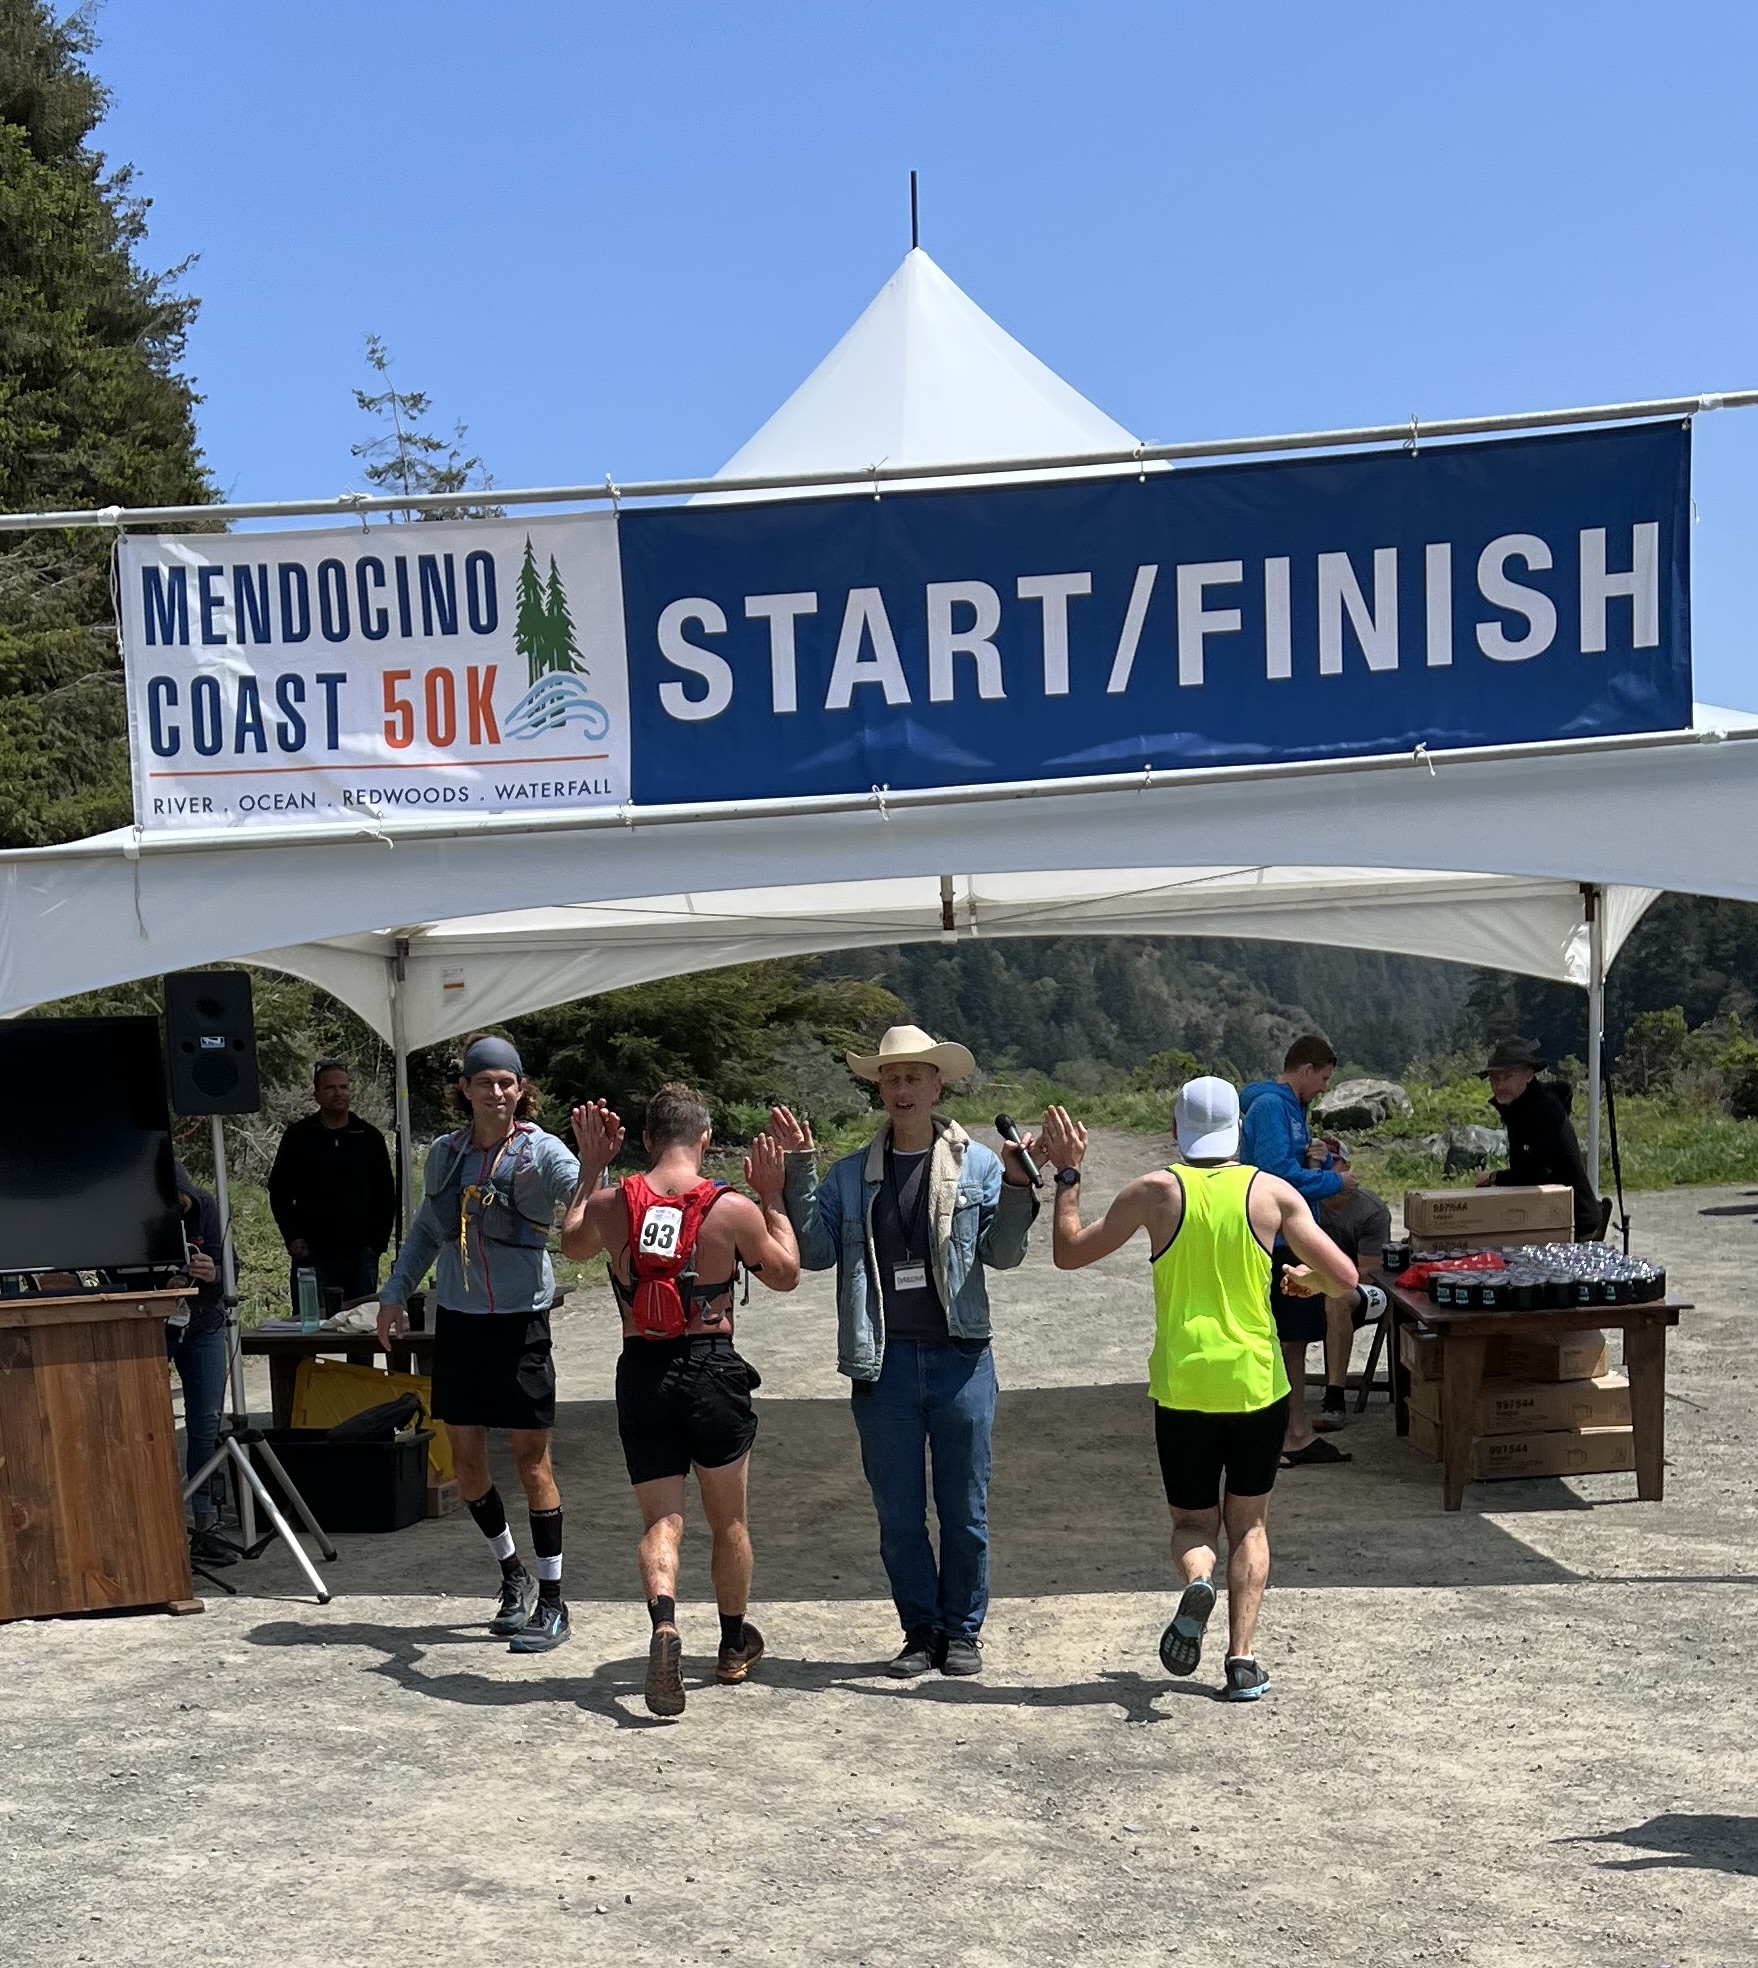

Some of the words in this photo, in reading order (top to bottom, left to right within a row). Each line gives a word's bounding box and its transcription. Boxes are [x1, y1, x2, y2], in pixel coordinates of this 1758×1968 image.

[142, 550, 499, 647] MENDOCINO
[658, 522, 1659, 721] START/FINISH
[147, 671, 348, 758] COAST
[383, 666, 500, 750] 50K
[153, 796, 214, 815] RIVER
[238, 791, 316, 812] OCEAN
[342, 786, 470, 807] REDWOODS
[494, 779, 613, 801] WATERFALL
[642, 1222, 675, 1249] 93
